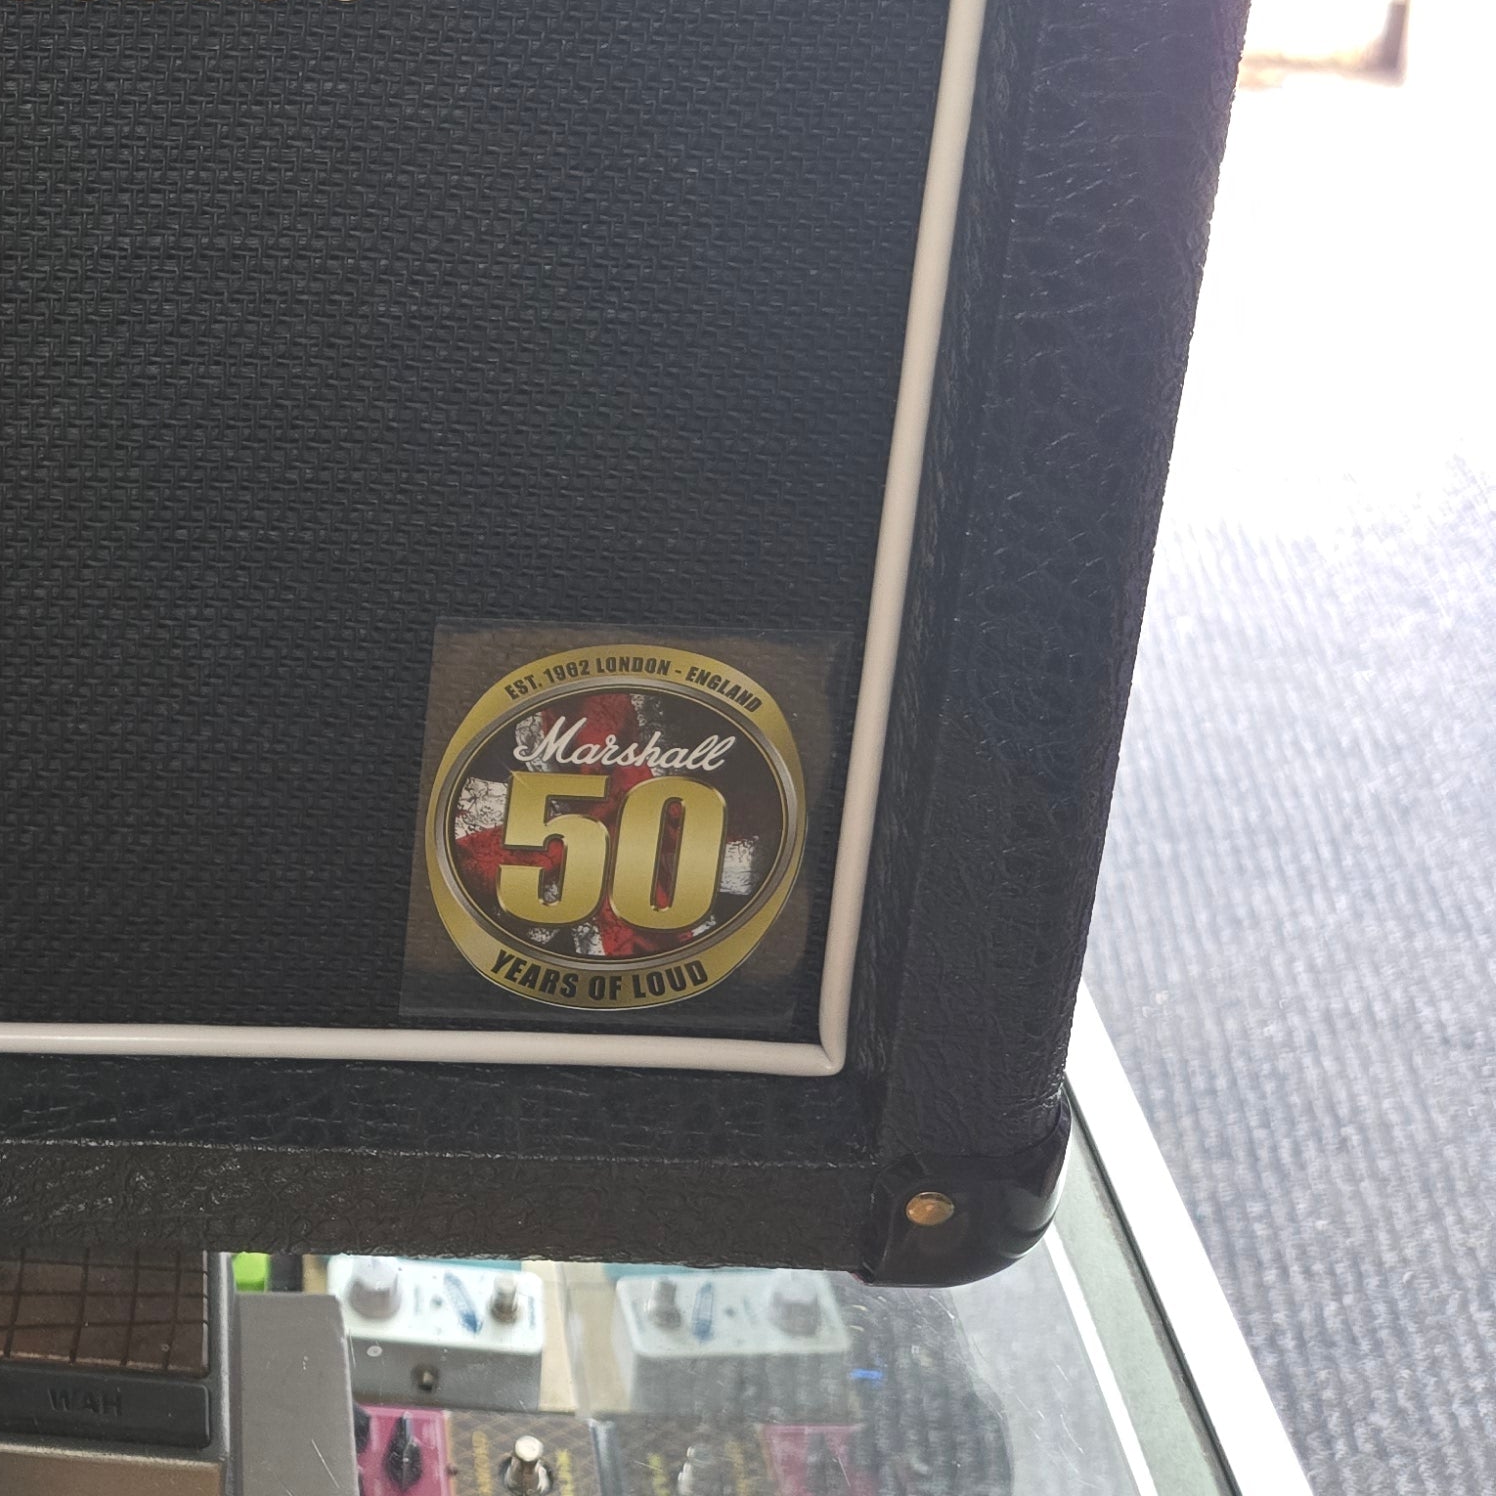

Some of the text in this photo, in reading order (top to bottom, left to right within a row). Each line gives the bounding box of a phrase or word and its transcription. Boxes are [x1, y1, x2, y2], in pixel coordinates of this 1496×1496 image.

[505, 674, 543, 701] EST.
[543, 659, 591, 684] 1962
[596, 656, 672, 677] LONDON
[685, 666, 763, 714] ENGLAND
[513, 715, 736, 771] Marshall
[496, 770, 728, 931] 50
[490, 948, 710, 1001] YEARS OF LOUD
